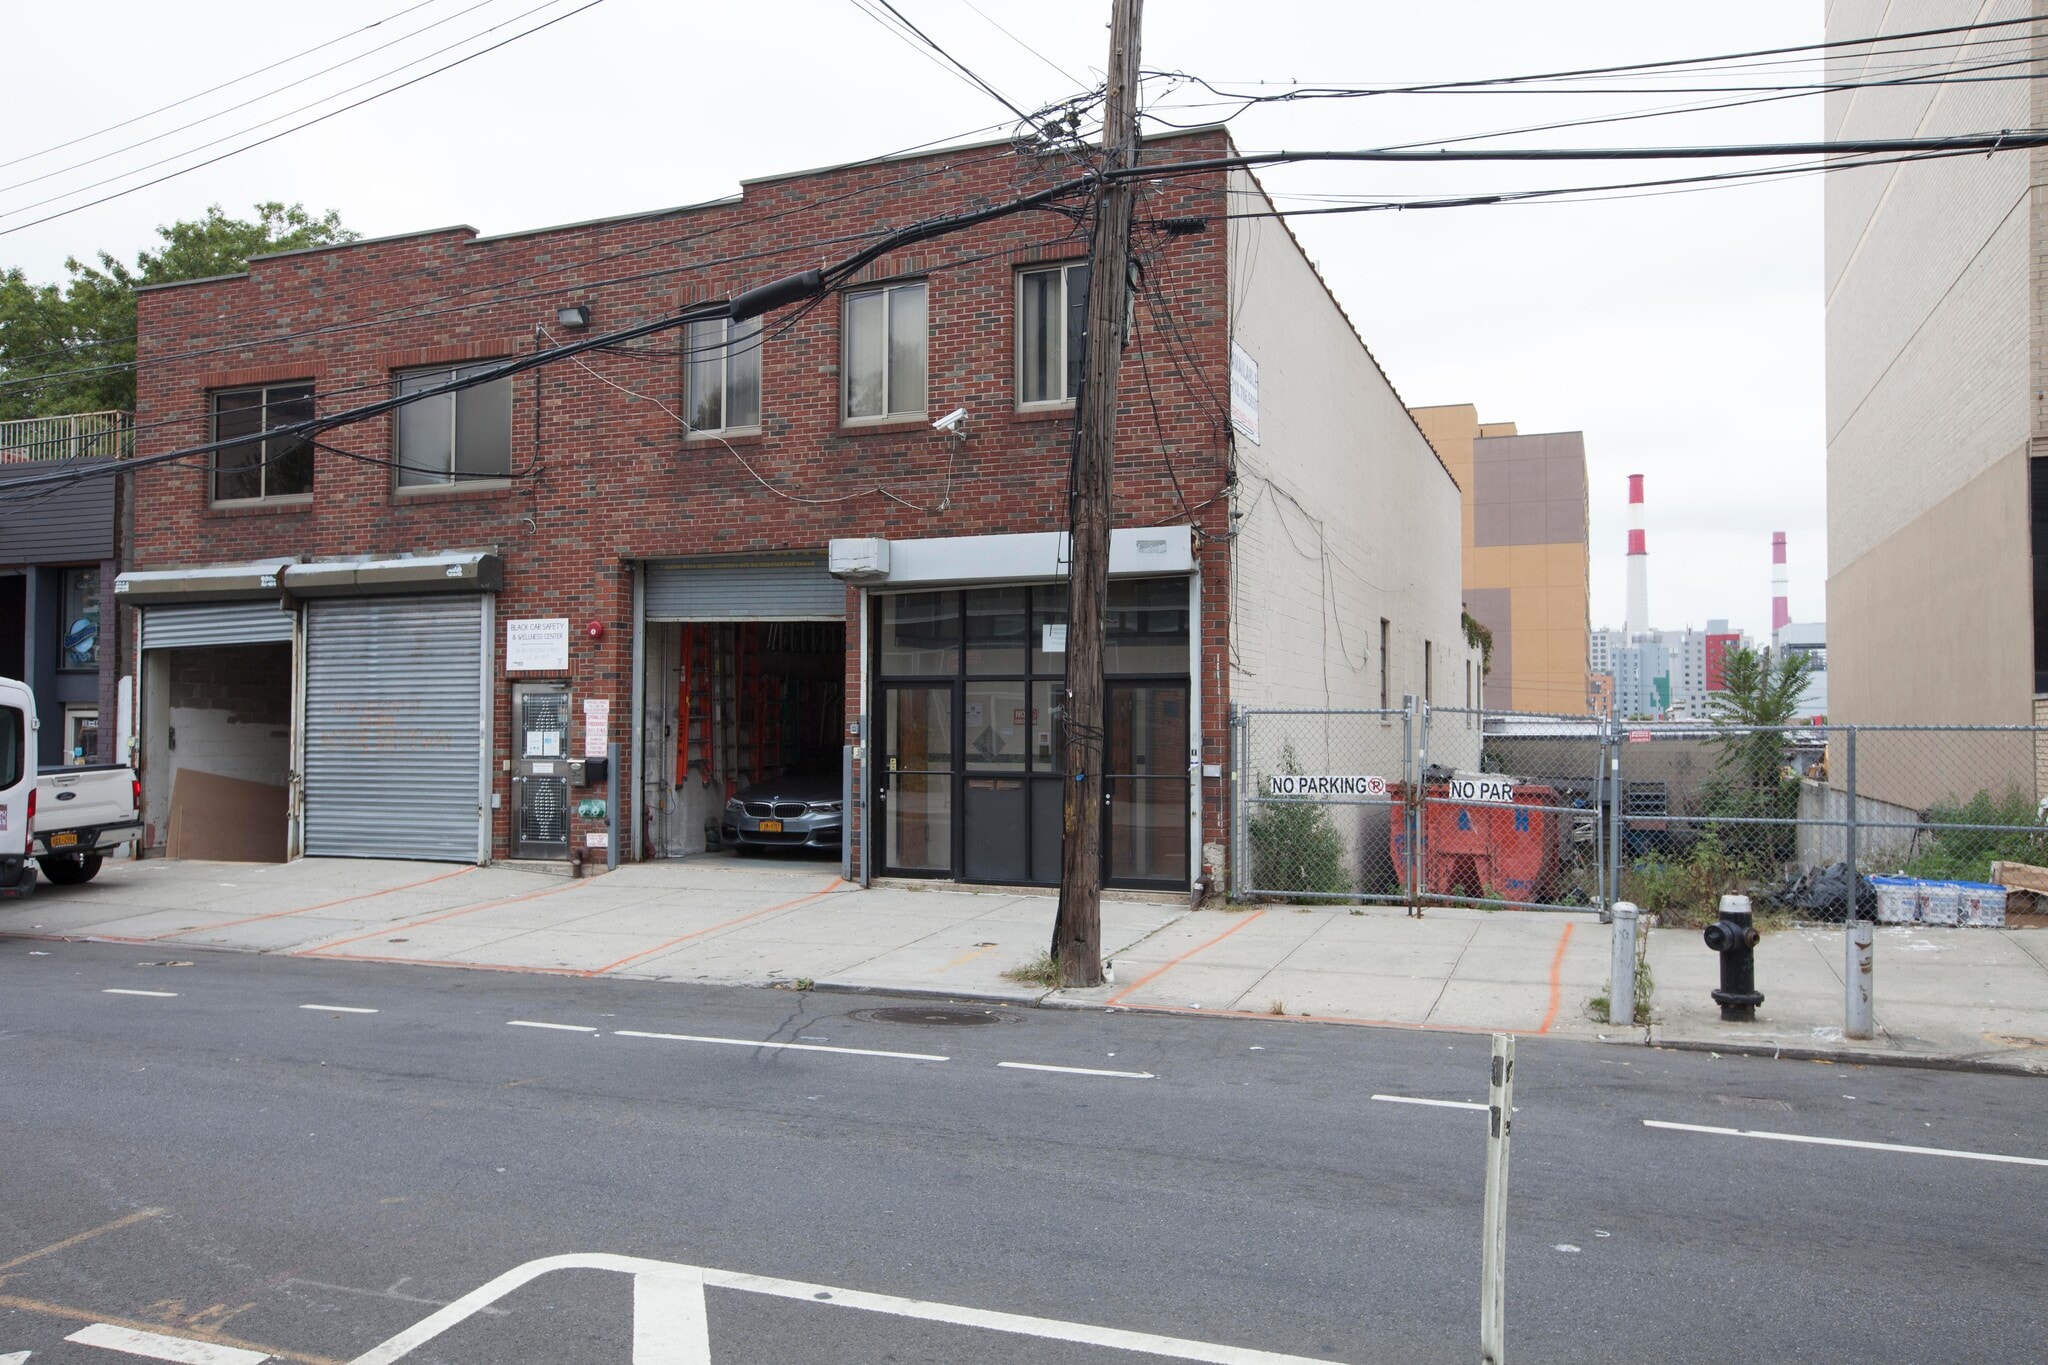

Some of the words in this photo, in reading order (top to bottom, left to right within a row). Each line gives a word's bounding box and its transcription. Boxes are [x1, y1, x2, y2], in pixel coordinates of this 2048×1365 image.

[1272, 777, 1294, 794] NO
[1299, 777, 1367, 794] PARKING
[1451, 782, 1475, 798] NO
